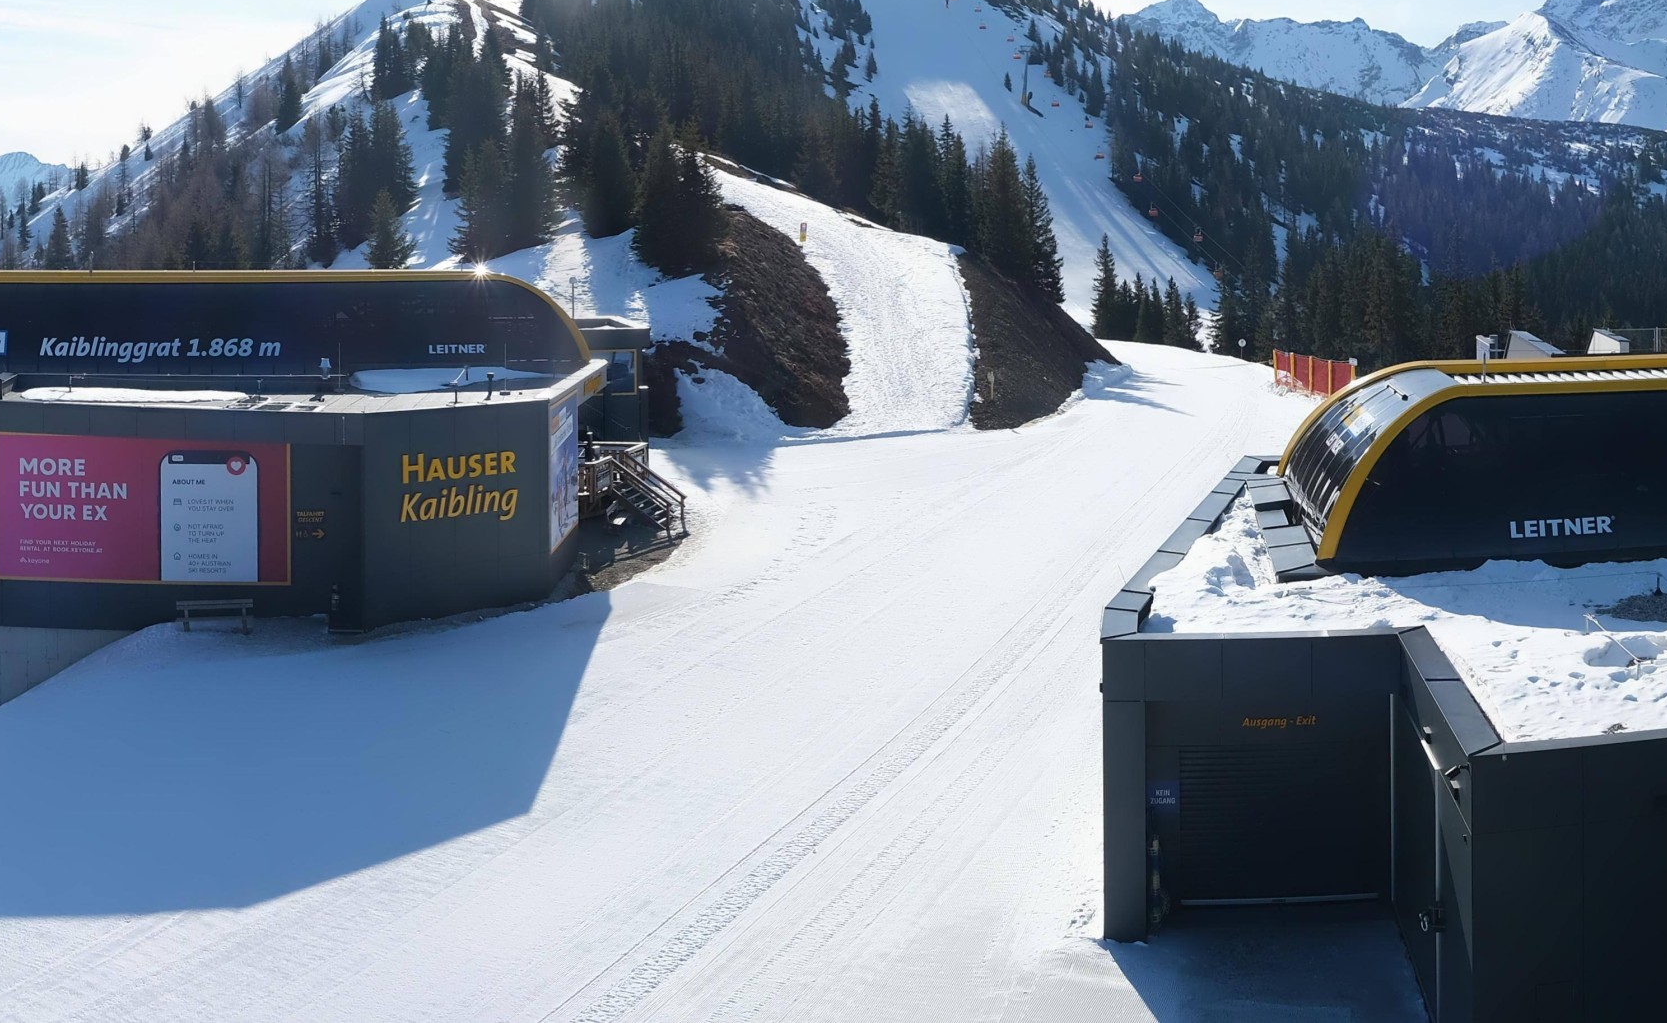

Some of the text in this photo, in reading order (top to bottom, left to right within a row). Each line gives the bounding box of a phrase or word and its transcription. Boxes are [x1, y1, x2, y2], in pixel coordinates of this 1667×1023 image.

[39, 337, 281, 363] Kaiblinggrat 1.868 m
[19, 457, 86, 476] MORE
[402, 451, 516, 484] HAUSER
[19, 481, 127, 500] FUN THAN
[20, 503, 108, 521] YOUR EX
[400, 484, 519, 522] Kaibling
[1242, 717, 1287, 729] Ausgang
[1296, 715, 1316, 726] Exit
[1150, 797, 1176, 805] ZUGANG
[1155, 789, 1171, 797] KEIN
